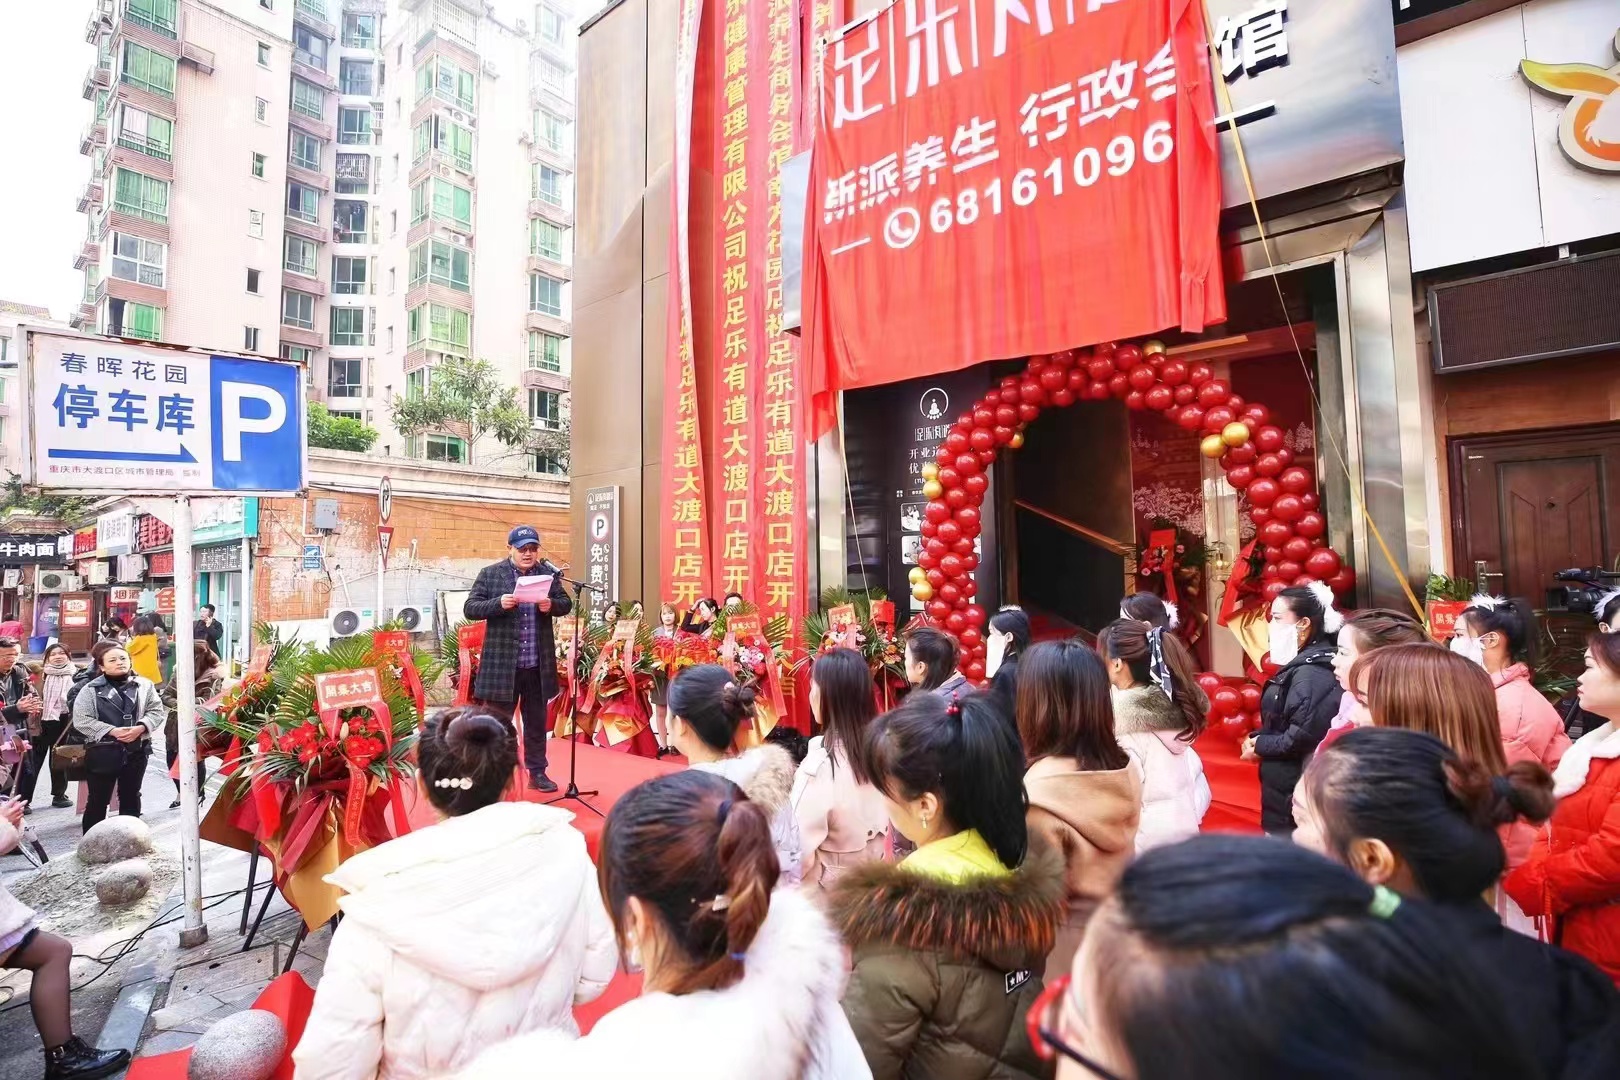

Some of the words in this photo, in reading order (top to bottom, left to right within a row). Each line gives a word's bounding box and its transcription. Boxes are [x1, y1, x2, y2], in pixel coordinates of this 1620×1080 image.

[823, 116, 1000, 224] 新派养生
[930, 120, 1174, 234] 68161096
[60, 352, 187, 384] 春晖花园
[52, 382, 195, 436] 停车库
[221, 380, 287, 462] P
[49, 464, 175, 477] 重庆市大渡口区城市管理局
[596, 518, 604, 536] P
[0, 542, 55, 557] 牛肉面
[114, 589, 140, 600] 烟酒
[590, 543, 604, 627] 免费停车
